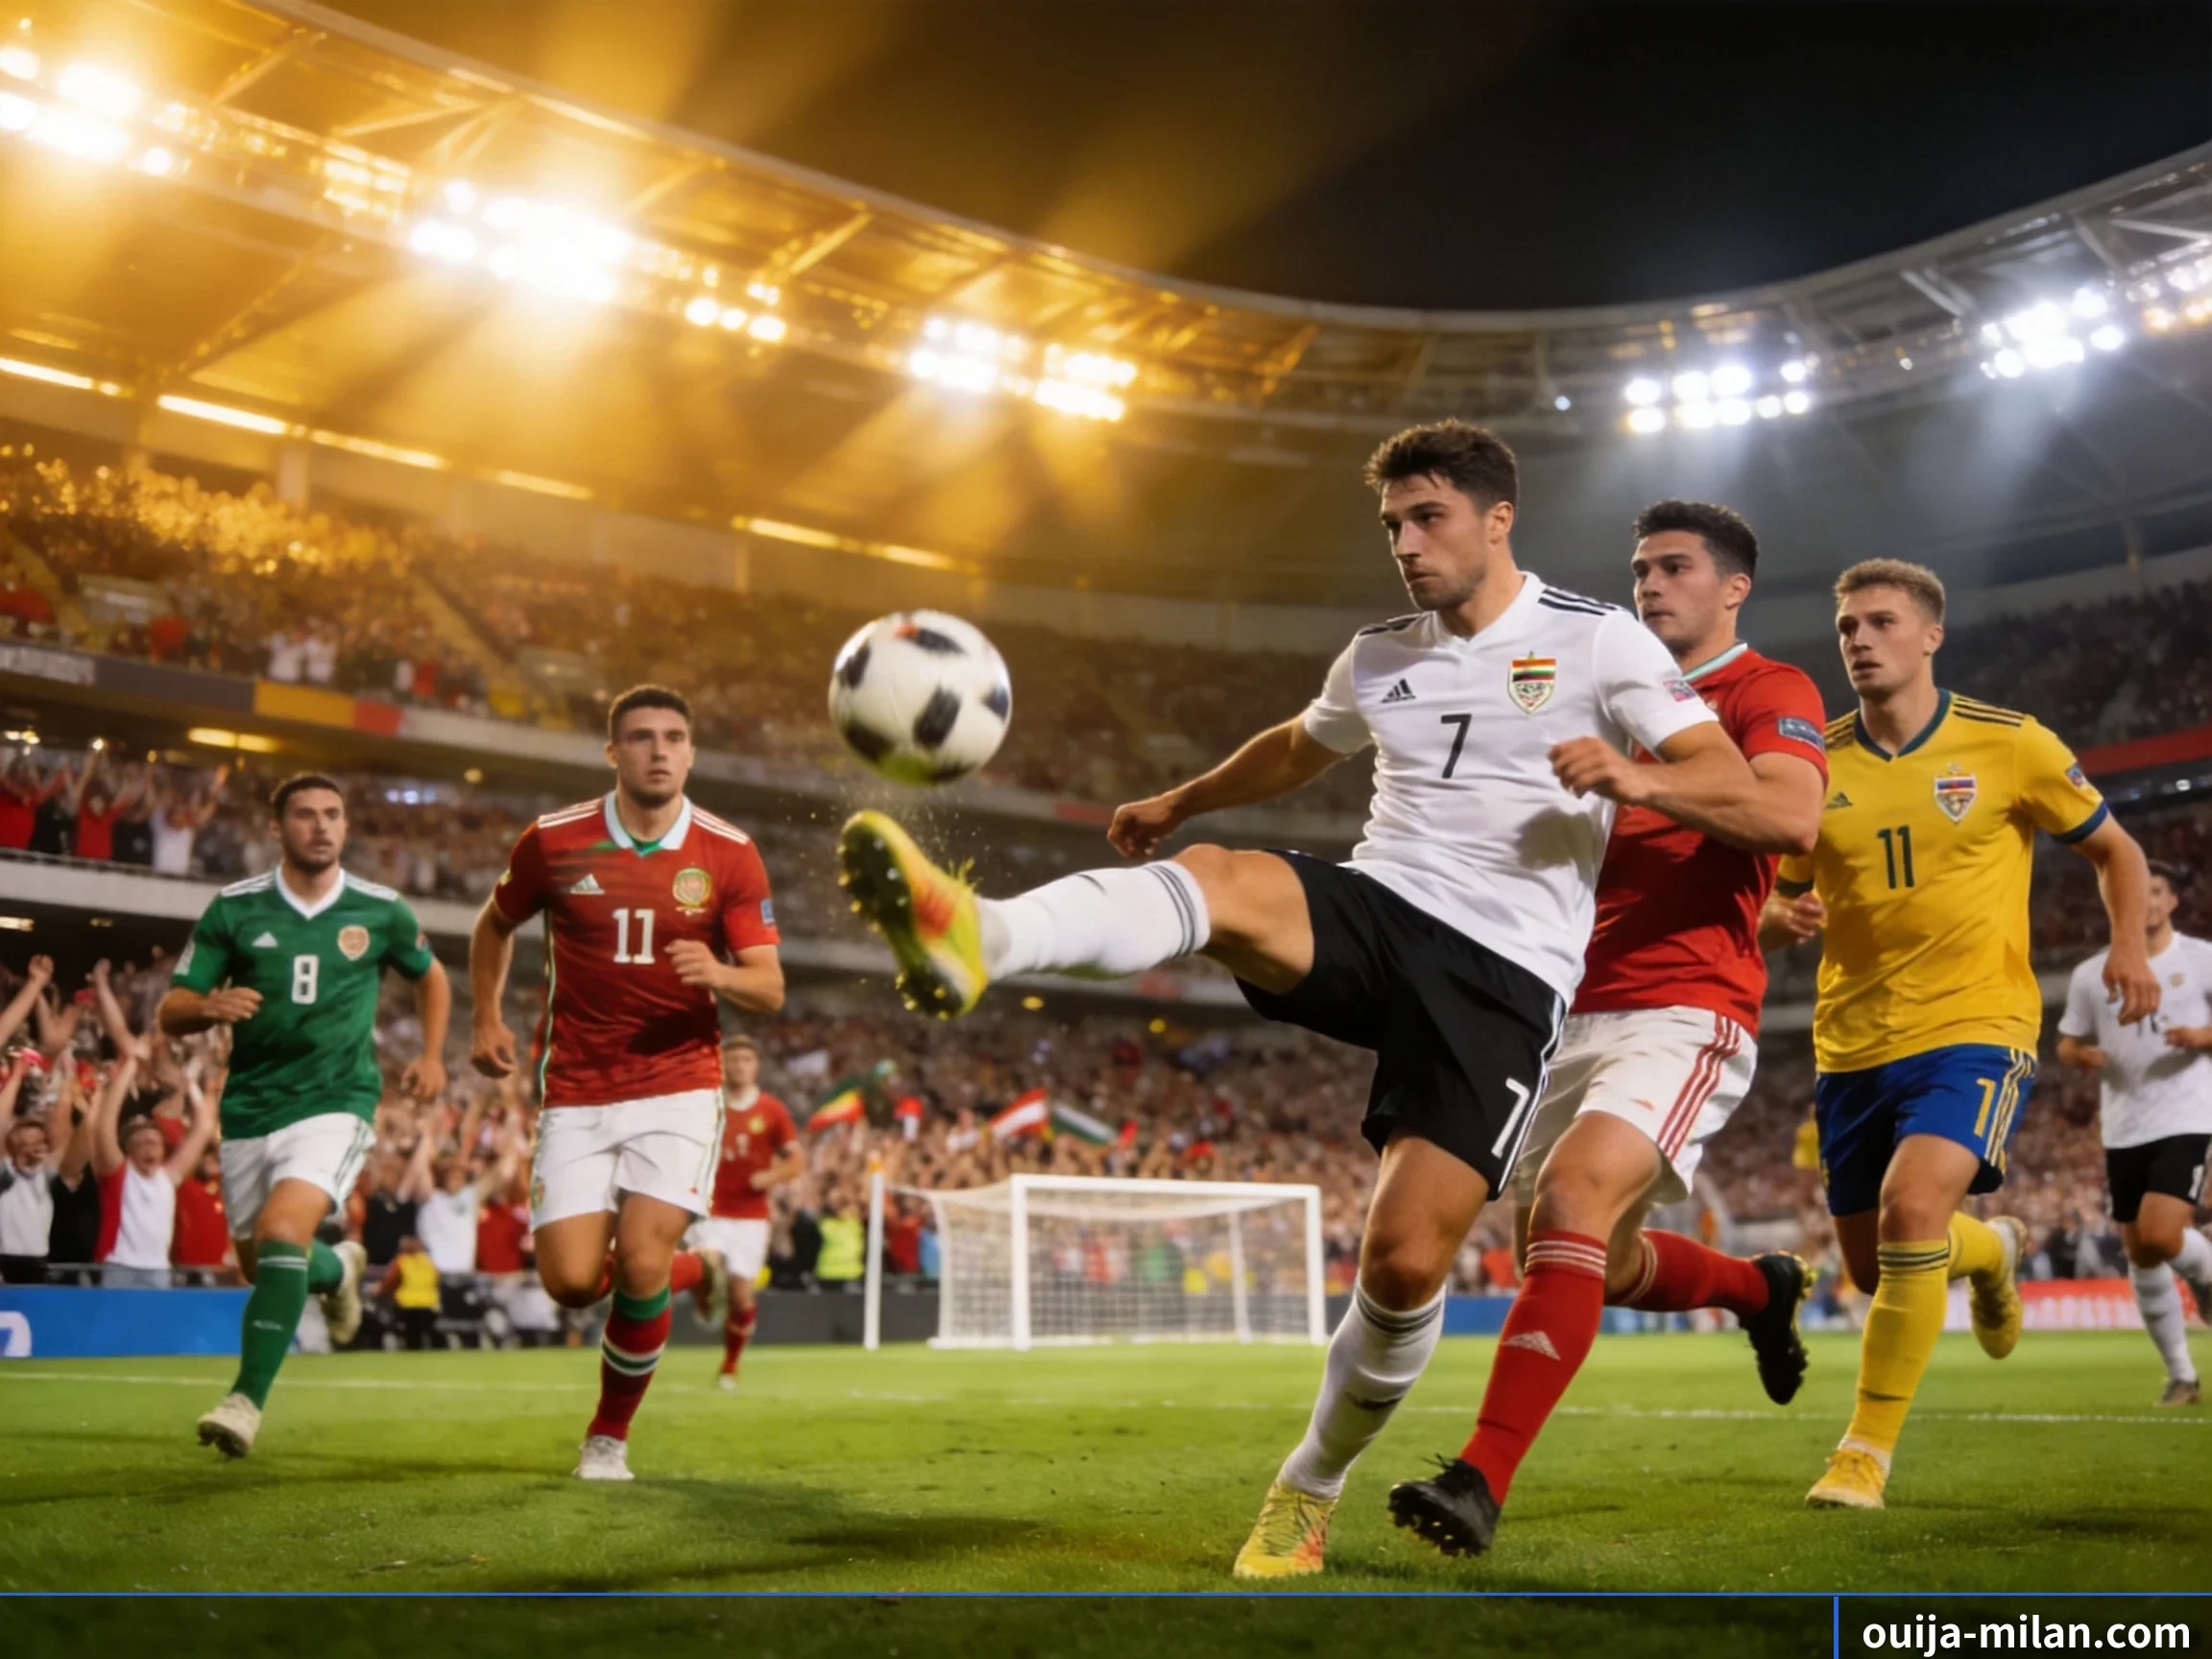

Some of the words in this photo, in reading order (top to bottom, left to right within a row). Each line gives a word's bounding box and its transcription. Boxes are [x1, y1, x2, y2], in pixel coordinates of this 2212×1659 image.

[1441, 713, 1473, 779] 7
[1877, 824, 1914, 890] 11
[612, 907, 655, 964] 11
[292, 954, 319, 1004] 8
